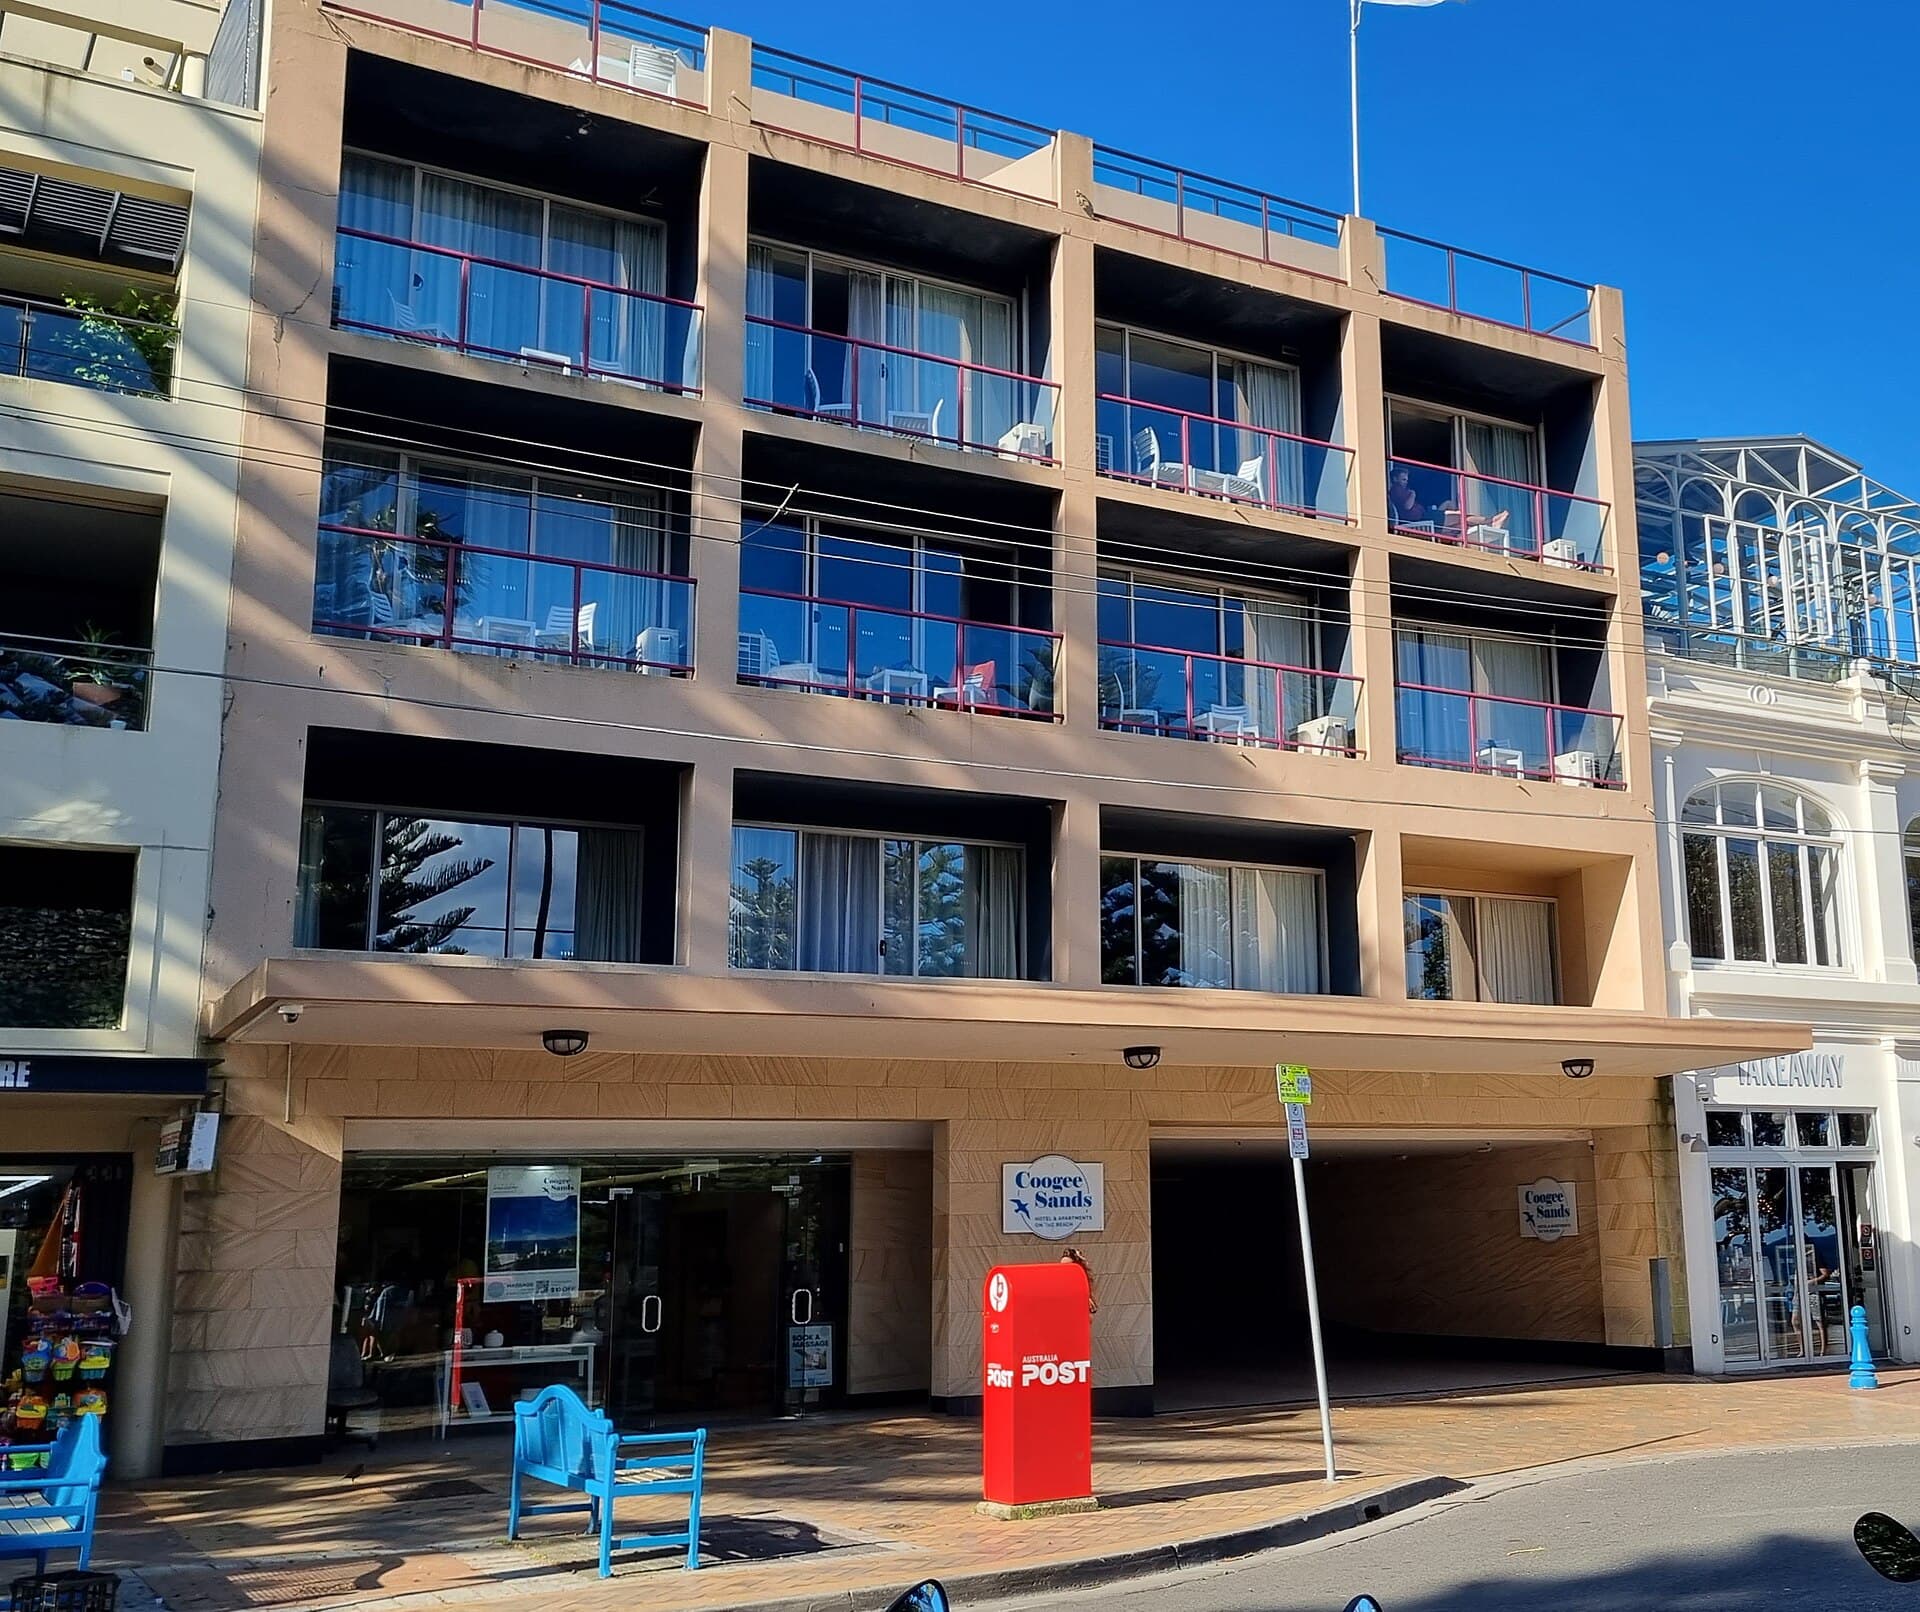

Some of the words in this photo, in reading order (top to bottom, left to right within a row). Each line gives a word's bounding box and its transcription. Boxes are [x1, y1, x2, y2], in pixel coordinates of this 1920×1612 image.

[0, 1060, 31, 1088] RE
[1737, 1054, 1844, 1088] TAKEAWAY
[1015, 1171, 1083, 1193] Coogee
[1035, 1190, 1093, 1208] Sands
[1525, 1190, 1564, 1206] Coogee
[1536, 1204, 1570, 1219] Sands
[792, 1340, 829, 1348] MASSAGE
[1022, 1354, 1058, 1363] AUSTRALIA
[987, 1368, 1014, 1388] POST
[1022, 1360, 1091, 1387] POST
